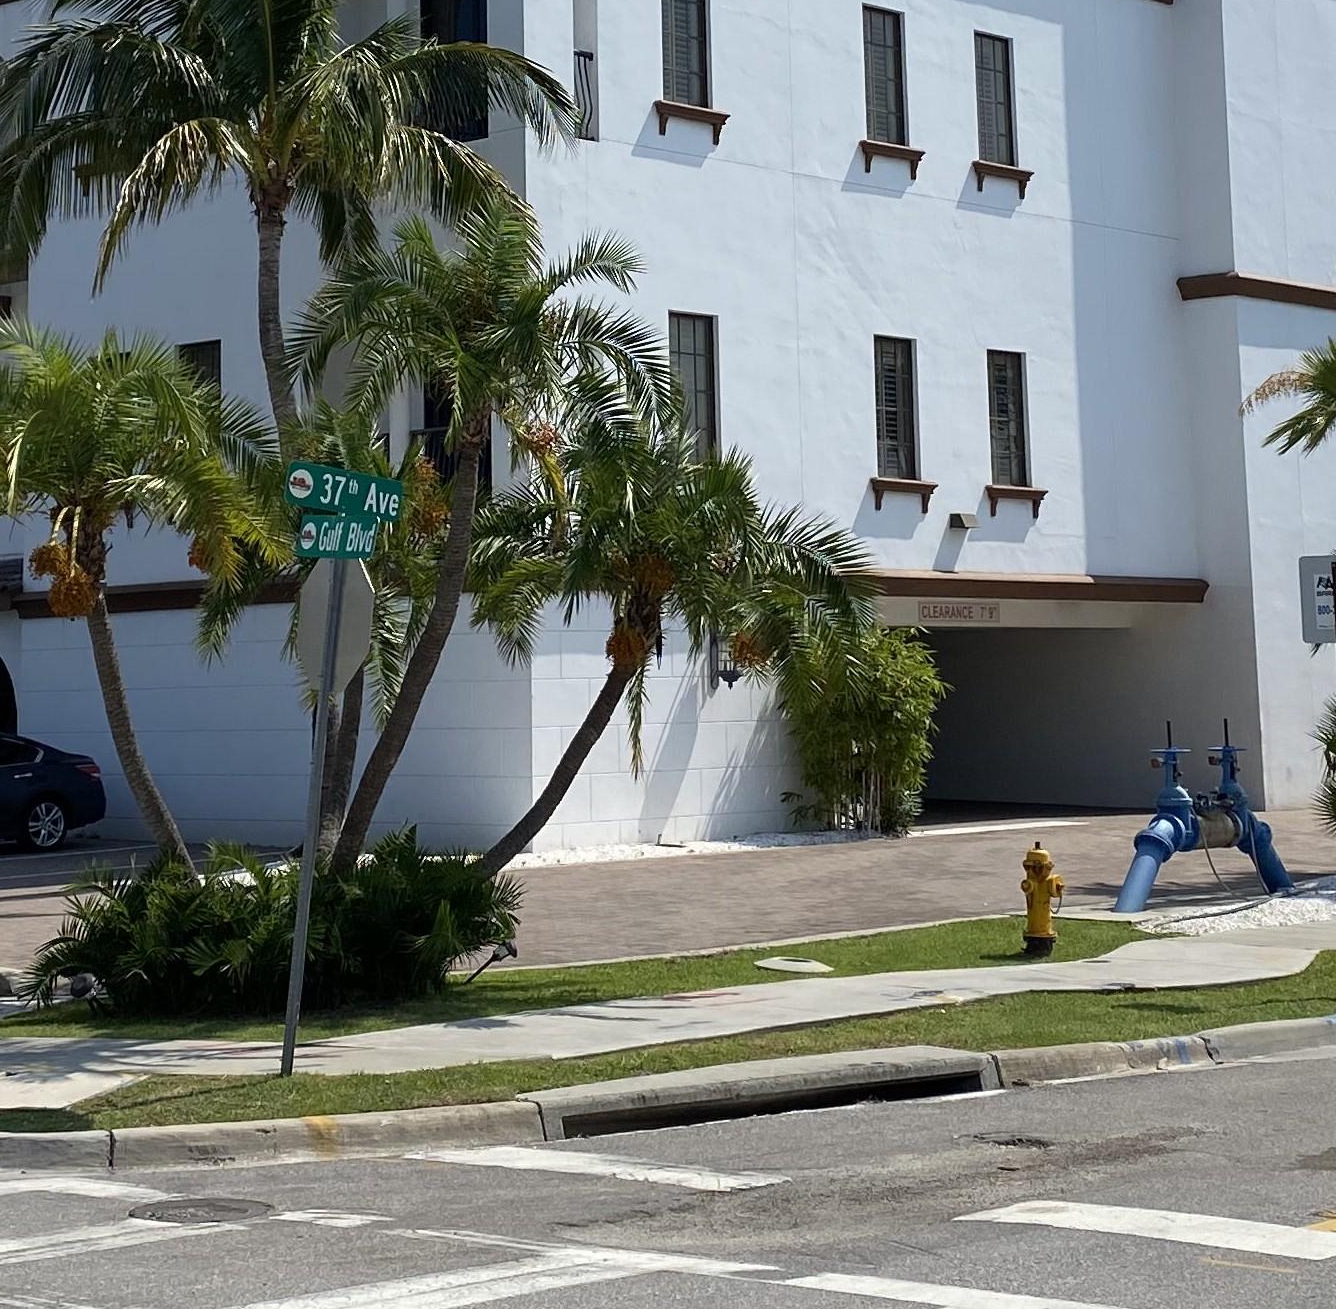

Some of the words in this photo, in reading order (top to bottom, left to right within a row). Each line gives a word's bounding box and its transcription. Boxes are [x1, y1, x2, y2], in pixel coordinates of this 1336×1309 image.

[320, 473, 359, 506] 37th
[364, 482, 399, 516] Ave
[318, 521, 344, 551] Gulf
[346, 522, 375, 553] Blvd
[921, 605, 974, 620] CLEARANCE
